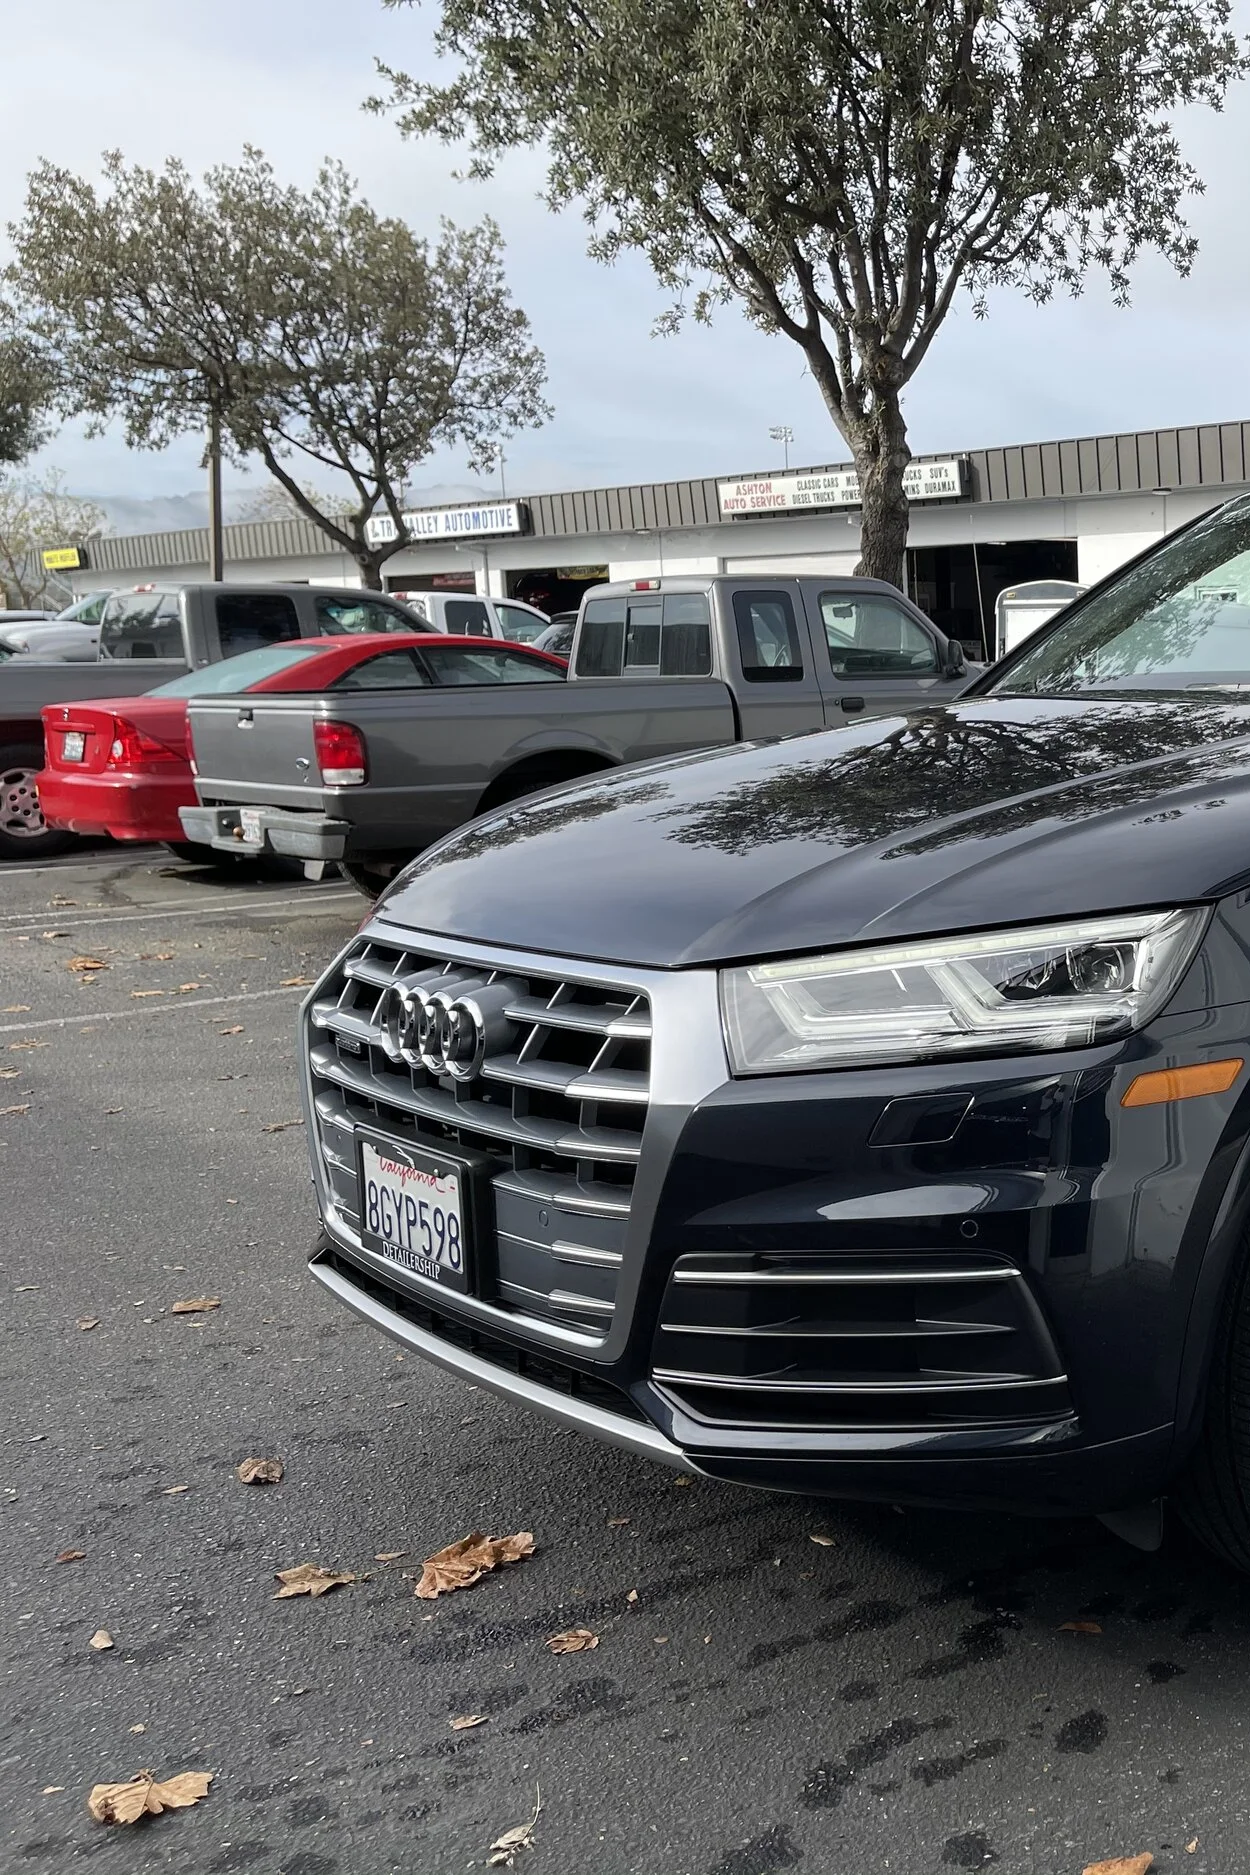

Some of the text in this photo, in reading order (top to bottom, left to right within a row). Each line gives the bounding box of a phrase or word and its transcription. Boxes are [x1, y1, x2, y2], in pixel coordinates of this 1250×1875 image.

[736, 482, 772, 496] ASHTON
[792, 493, 812, 505] DIESEL
[813, 491, 835, 503] TRUCKS
[925, 480, 957, 494] DURAMAX
[797, 478, 821, 491] CLASSIC
[823, 476, 839, 489] CARS
[724, 494, 786, 510] AUTO SERVICE
[445, 508, 513, 532] AUTOMOTIVE
[368, 1179, 461, 1270] 8GYP598
[382, 1241, 440, 1280] DETAILERSHIP
